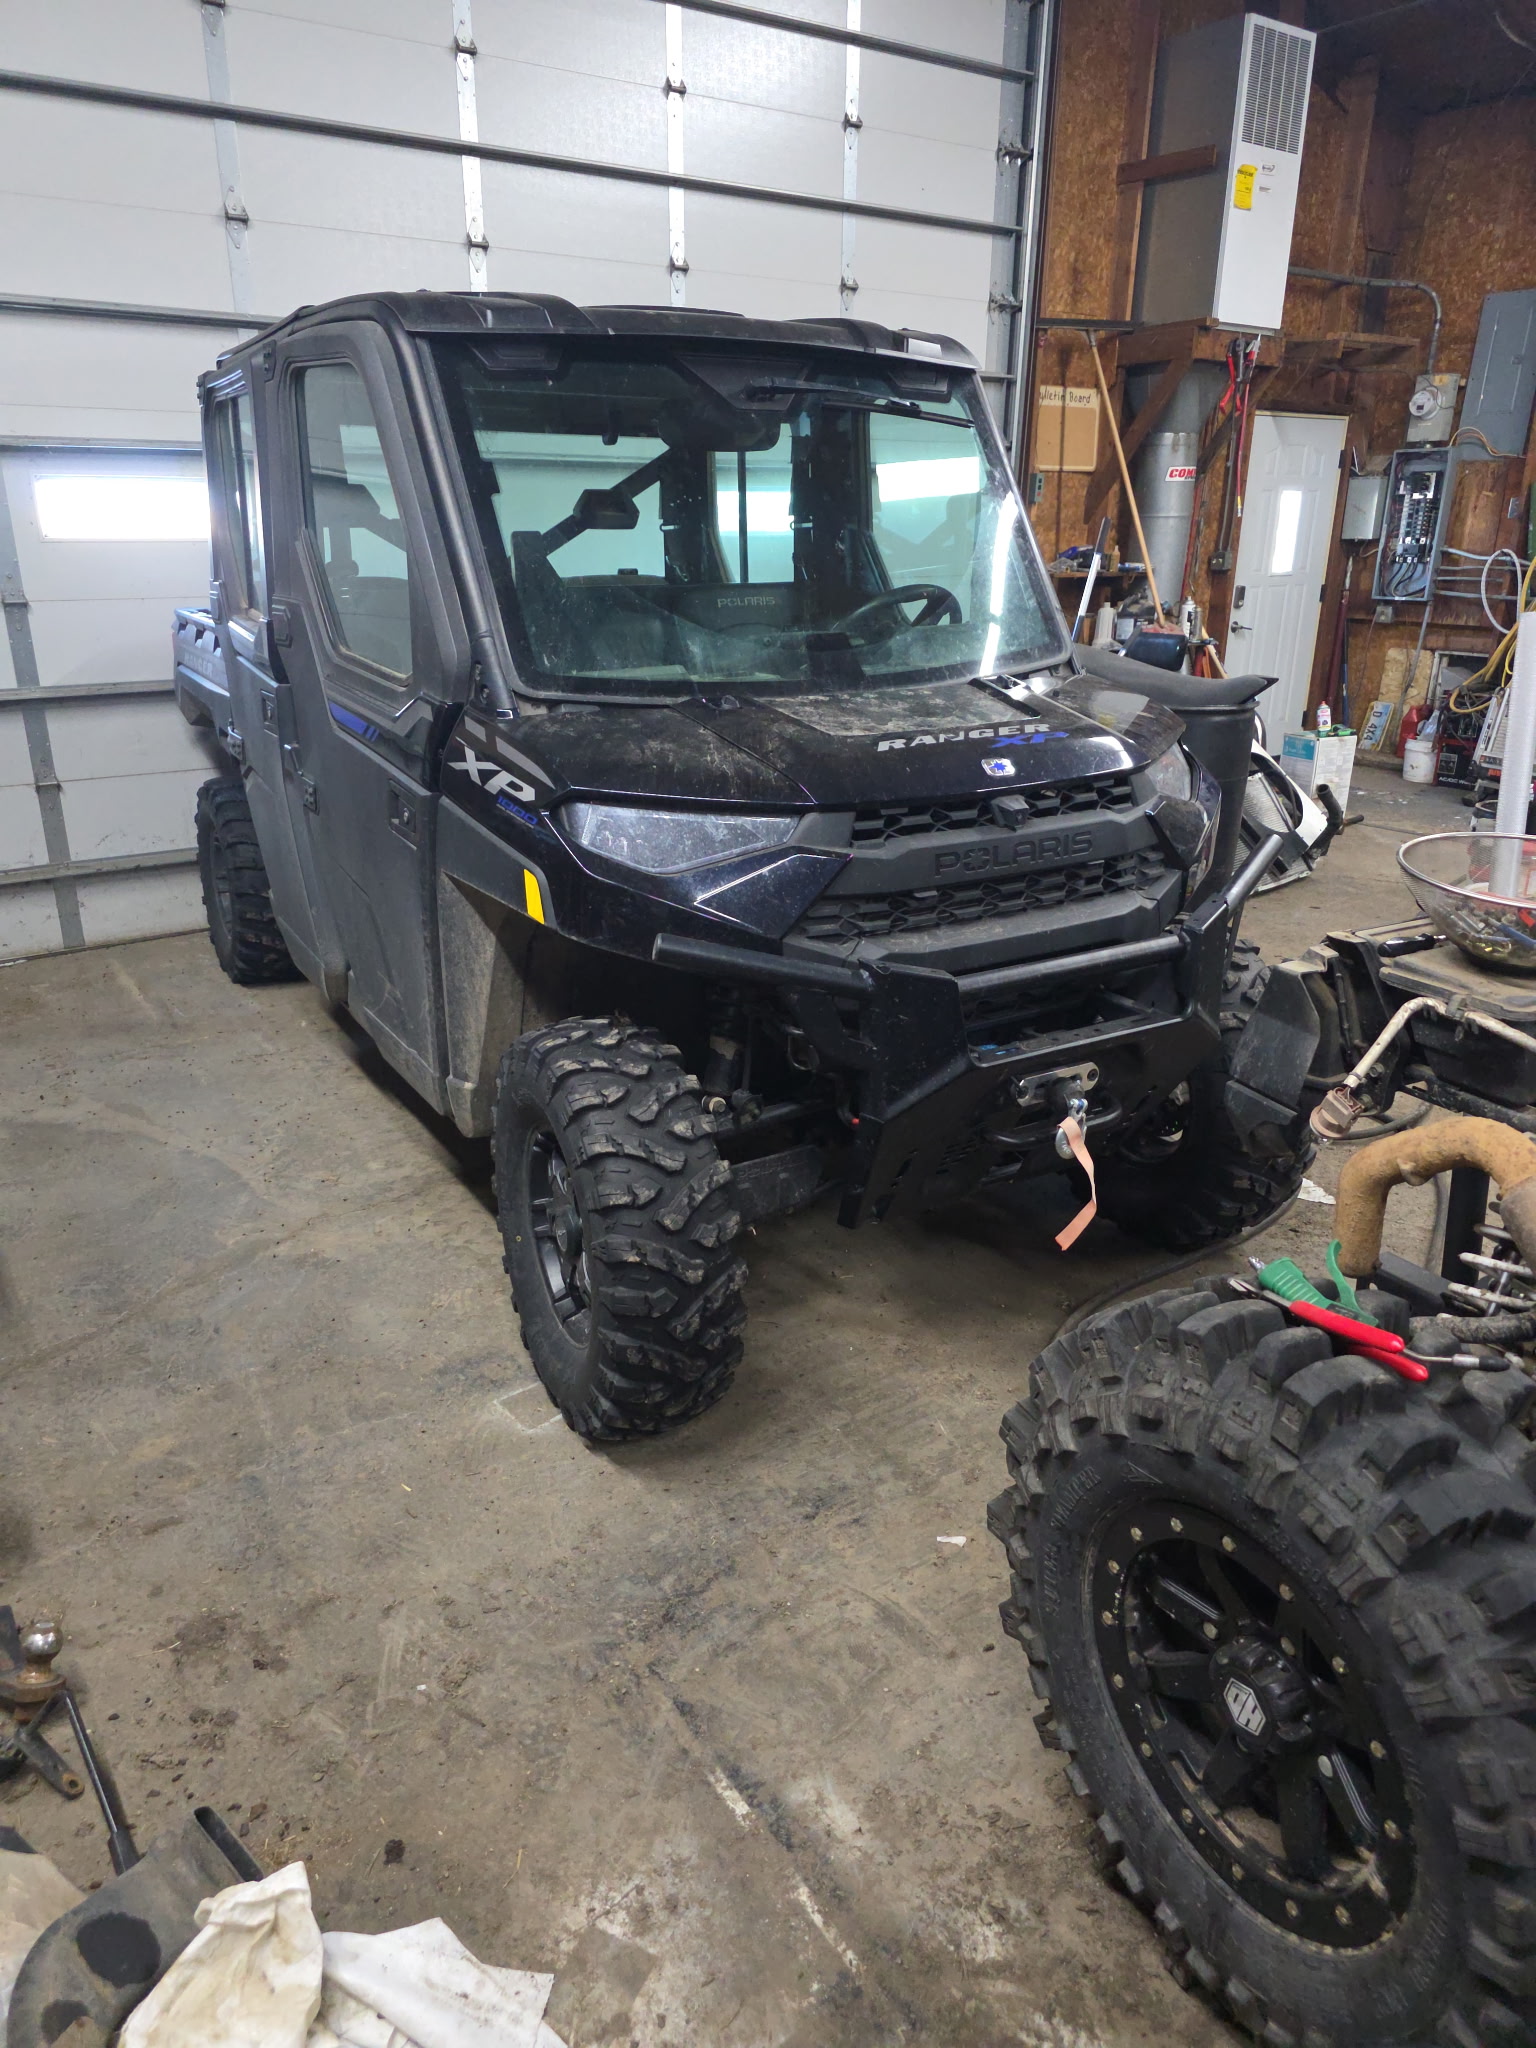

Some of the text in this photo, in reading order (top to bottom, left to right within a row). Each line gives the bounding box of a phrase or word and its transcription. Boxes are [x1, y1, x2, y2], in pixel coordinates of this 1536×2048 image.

[1069, 391, 1092, 404] Board
[717, 596, 776, 608] POLARIS
[877, 724, 1052, 751] RANGER
[991, 731, 1070, 748] XP
[447, 746, 535, 802] XP
[497, 796, 538, 825] 1000
[934, 831, 1093, 878] POLARIS
